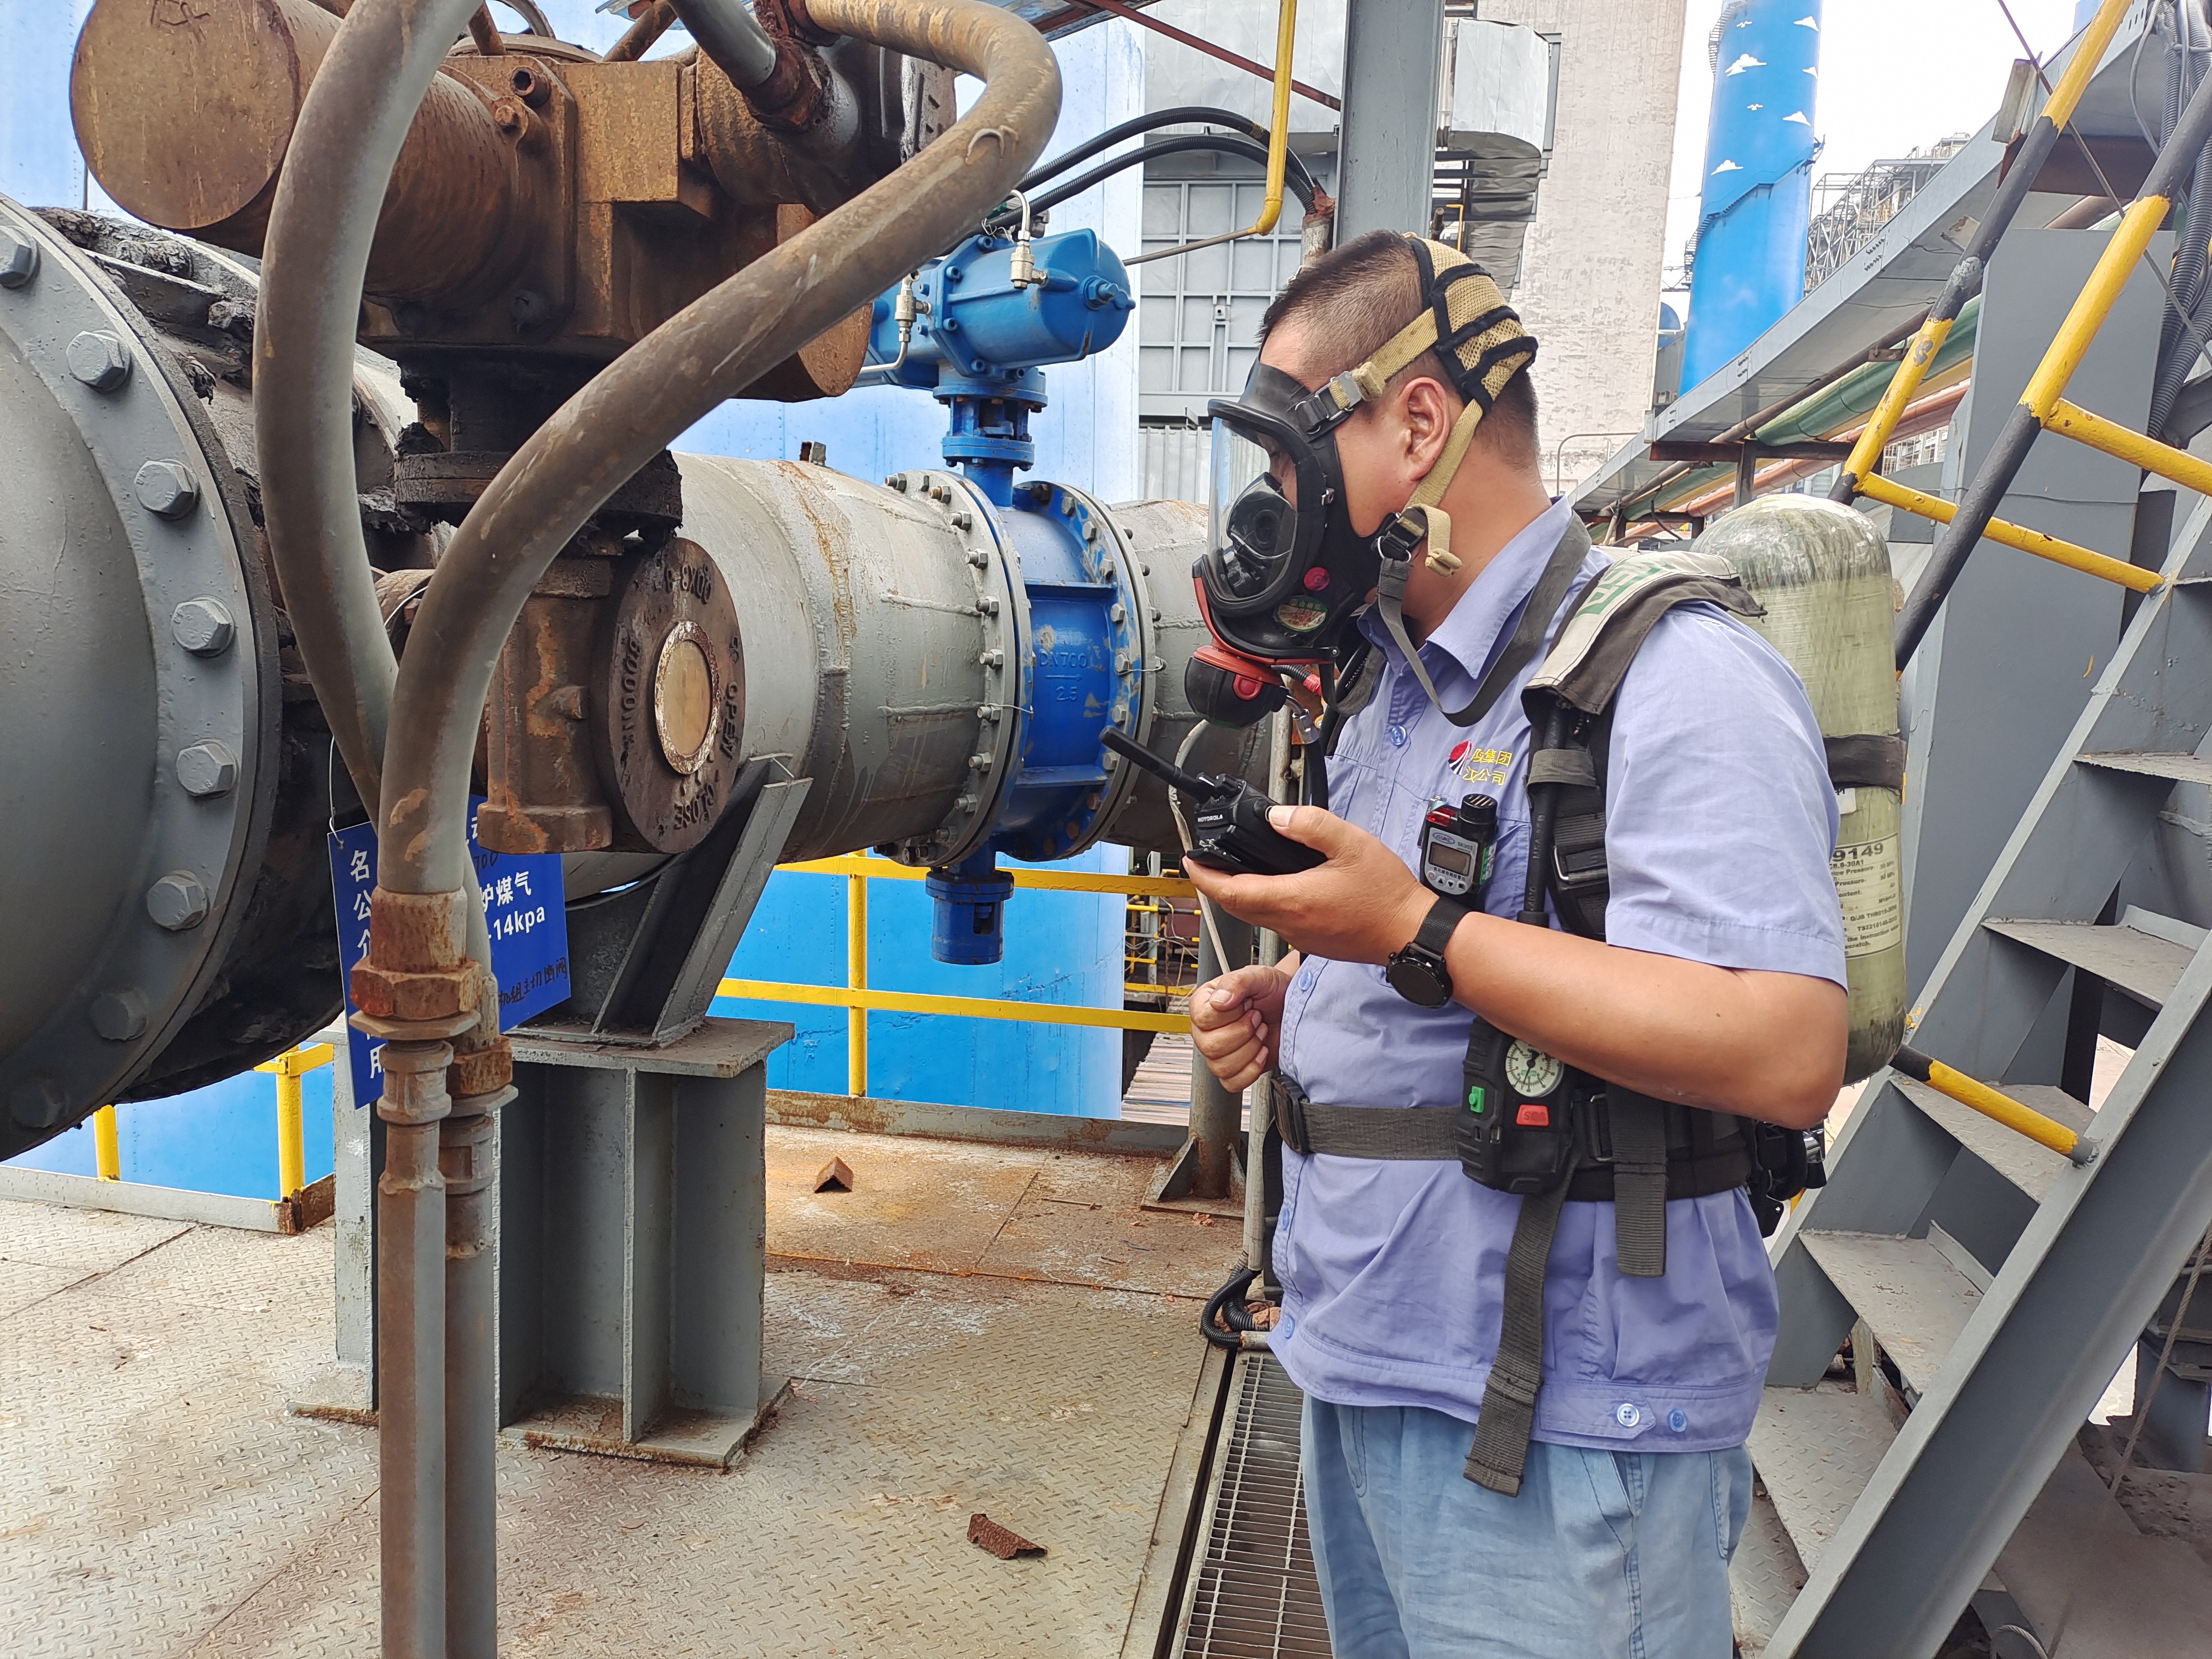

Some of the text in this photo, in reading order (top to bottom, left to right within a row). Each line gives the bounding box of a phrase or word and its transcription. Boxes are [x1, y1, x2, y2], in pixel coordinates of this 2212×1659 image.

[1039, 648, 1088, 668] DN700
[720, 681, 738, 760] OPEN
[1197, 814, 1223, 822] MOTOROLA
[1832, 842, 1884, 862] 9149
[350, 850, 369, 882] 名
[479, 871, 531, 912] 炉煤气
